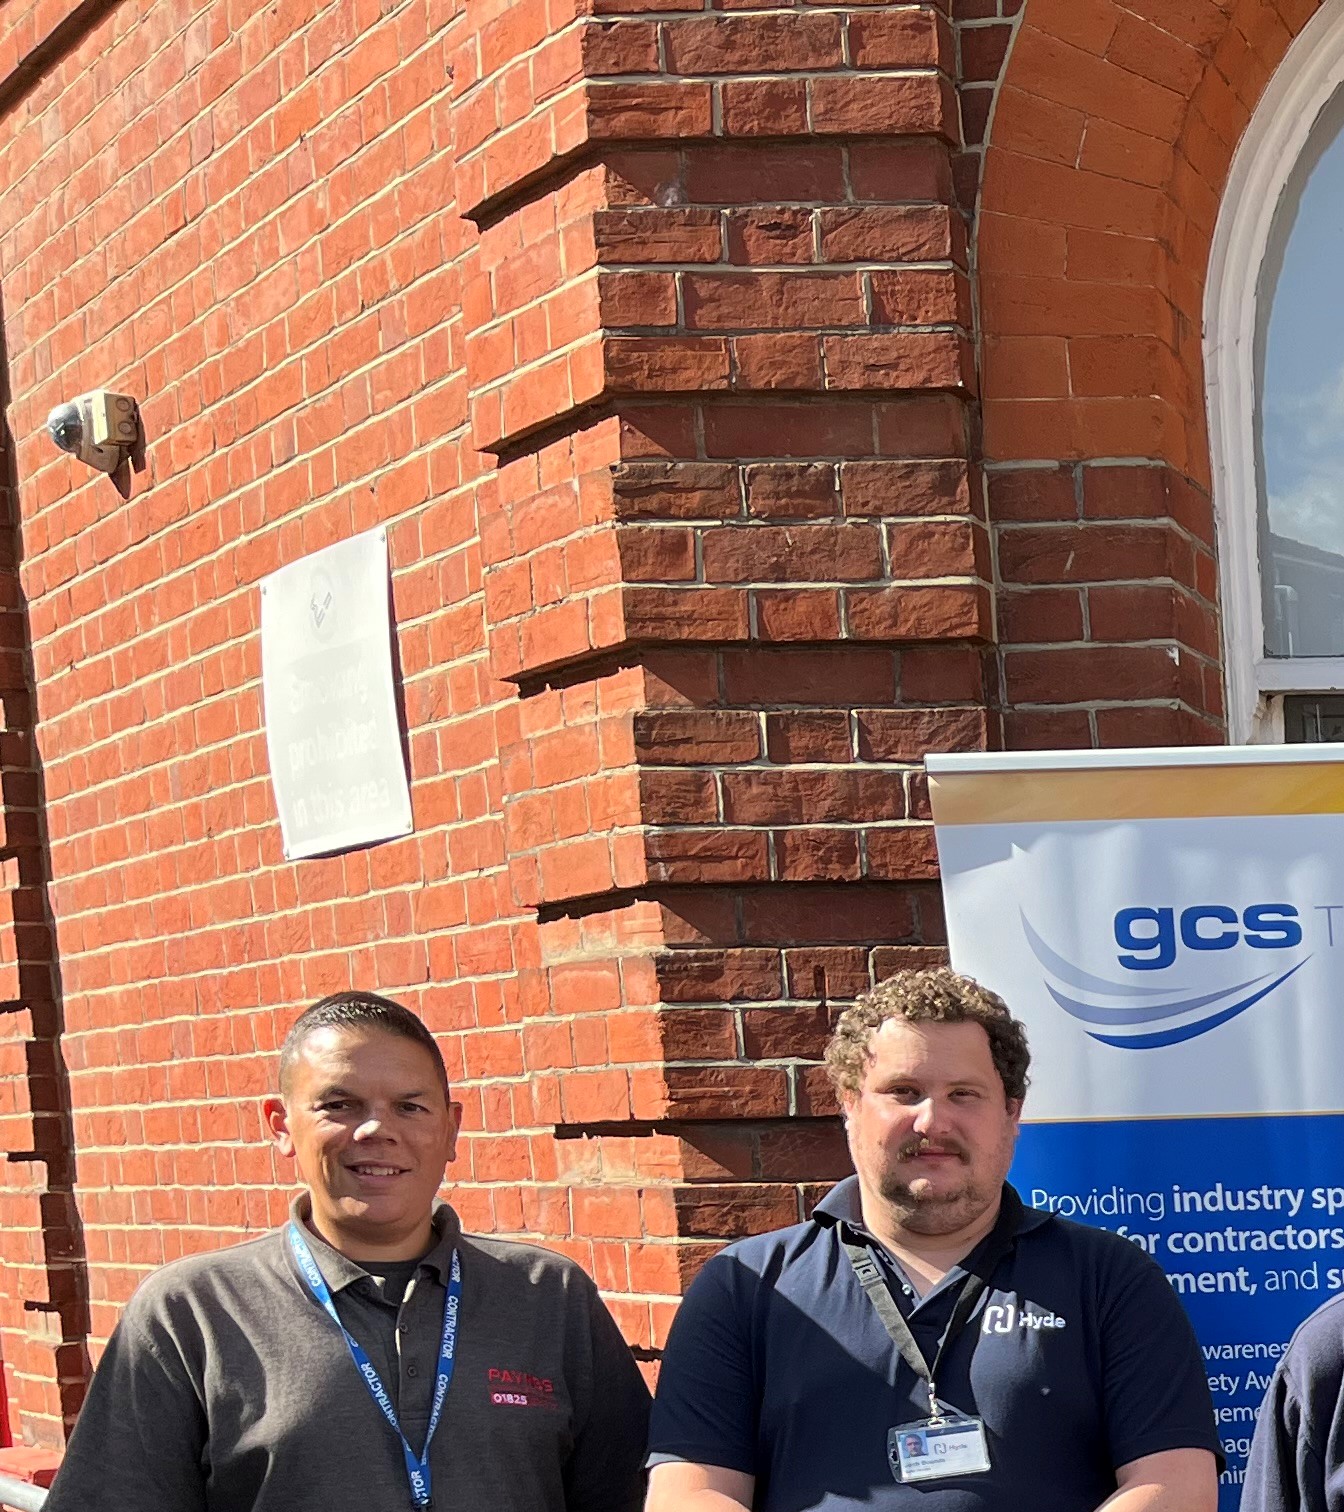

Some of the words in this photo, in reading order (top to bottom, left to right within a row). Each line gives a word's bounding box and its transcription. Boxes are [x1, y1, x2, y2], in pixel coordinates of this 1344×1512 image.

[1113, 903, 1303, 971] gcs
[1031, 1185, 1166, 1221] Providing
[1172, 1183, 1304, 1218] industry
[1166, 1266, 1257, 1296] ment,
[1264, 1261, 1319, 1291] and
[441, 1295, 459, 1360] CONTRACTOR
[1018, 1311, 1067, 1330] Hyde
[493, 1393, 528, 1406] 01825
